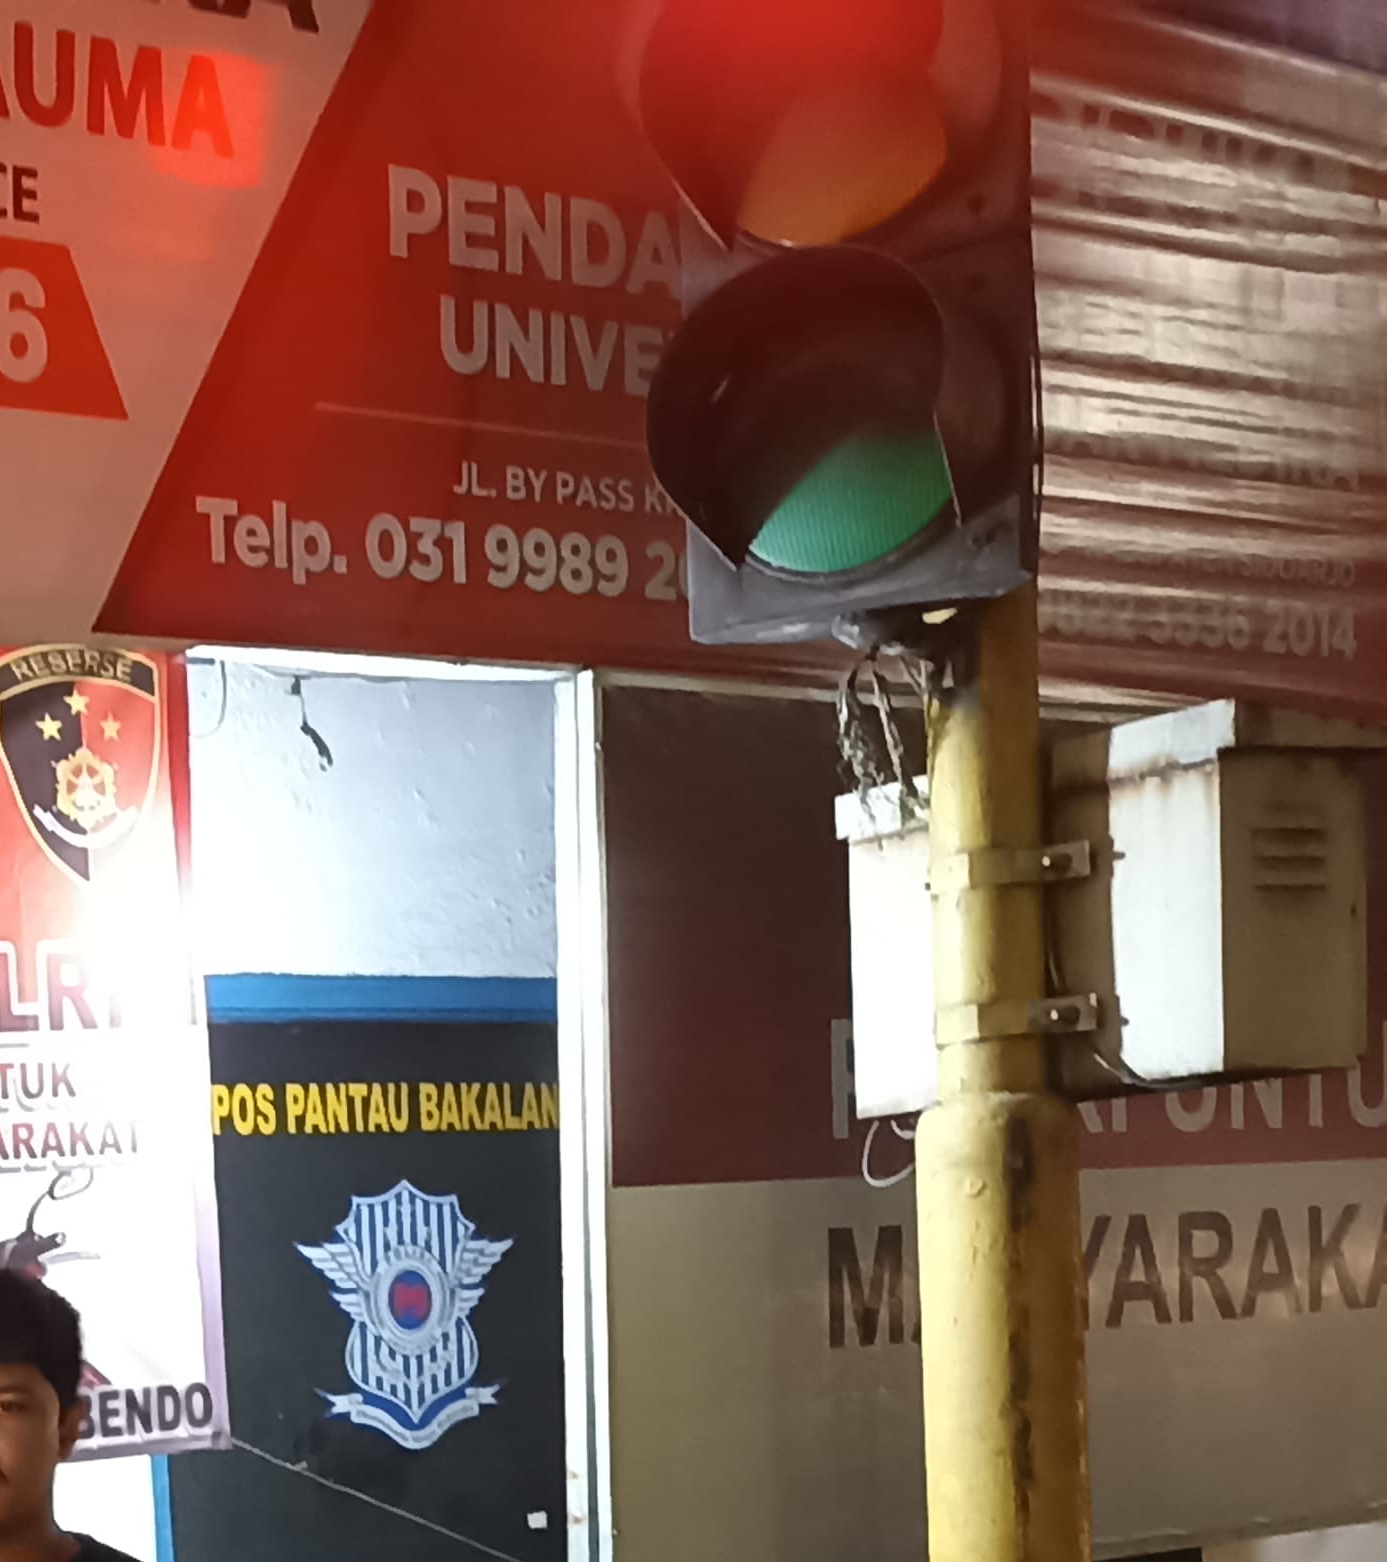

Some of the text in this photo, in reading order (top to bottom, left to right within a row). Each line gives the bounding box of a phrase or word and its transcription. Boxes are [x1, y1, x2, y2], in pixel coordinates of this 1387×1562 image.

[388, 163, 683, 295] PENDA
[440, 295, 674, 399] UNIVE
[453, 461, 497, 498] JL.
[507, 465, 548, 502] BY
[556, 470, 635, 514] PASS
[196, 496, 348, 586] Telp.
[366, 513, 467, 585] 031
[484, 521, 629, 600] 9989
[9, 647, 134, 682] RESERSE
[211, 1081, 558, 1135] POS PANTAU BAKALAN
